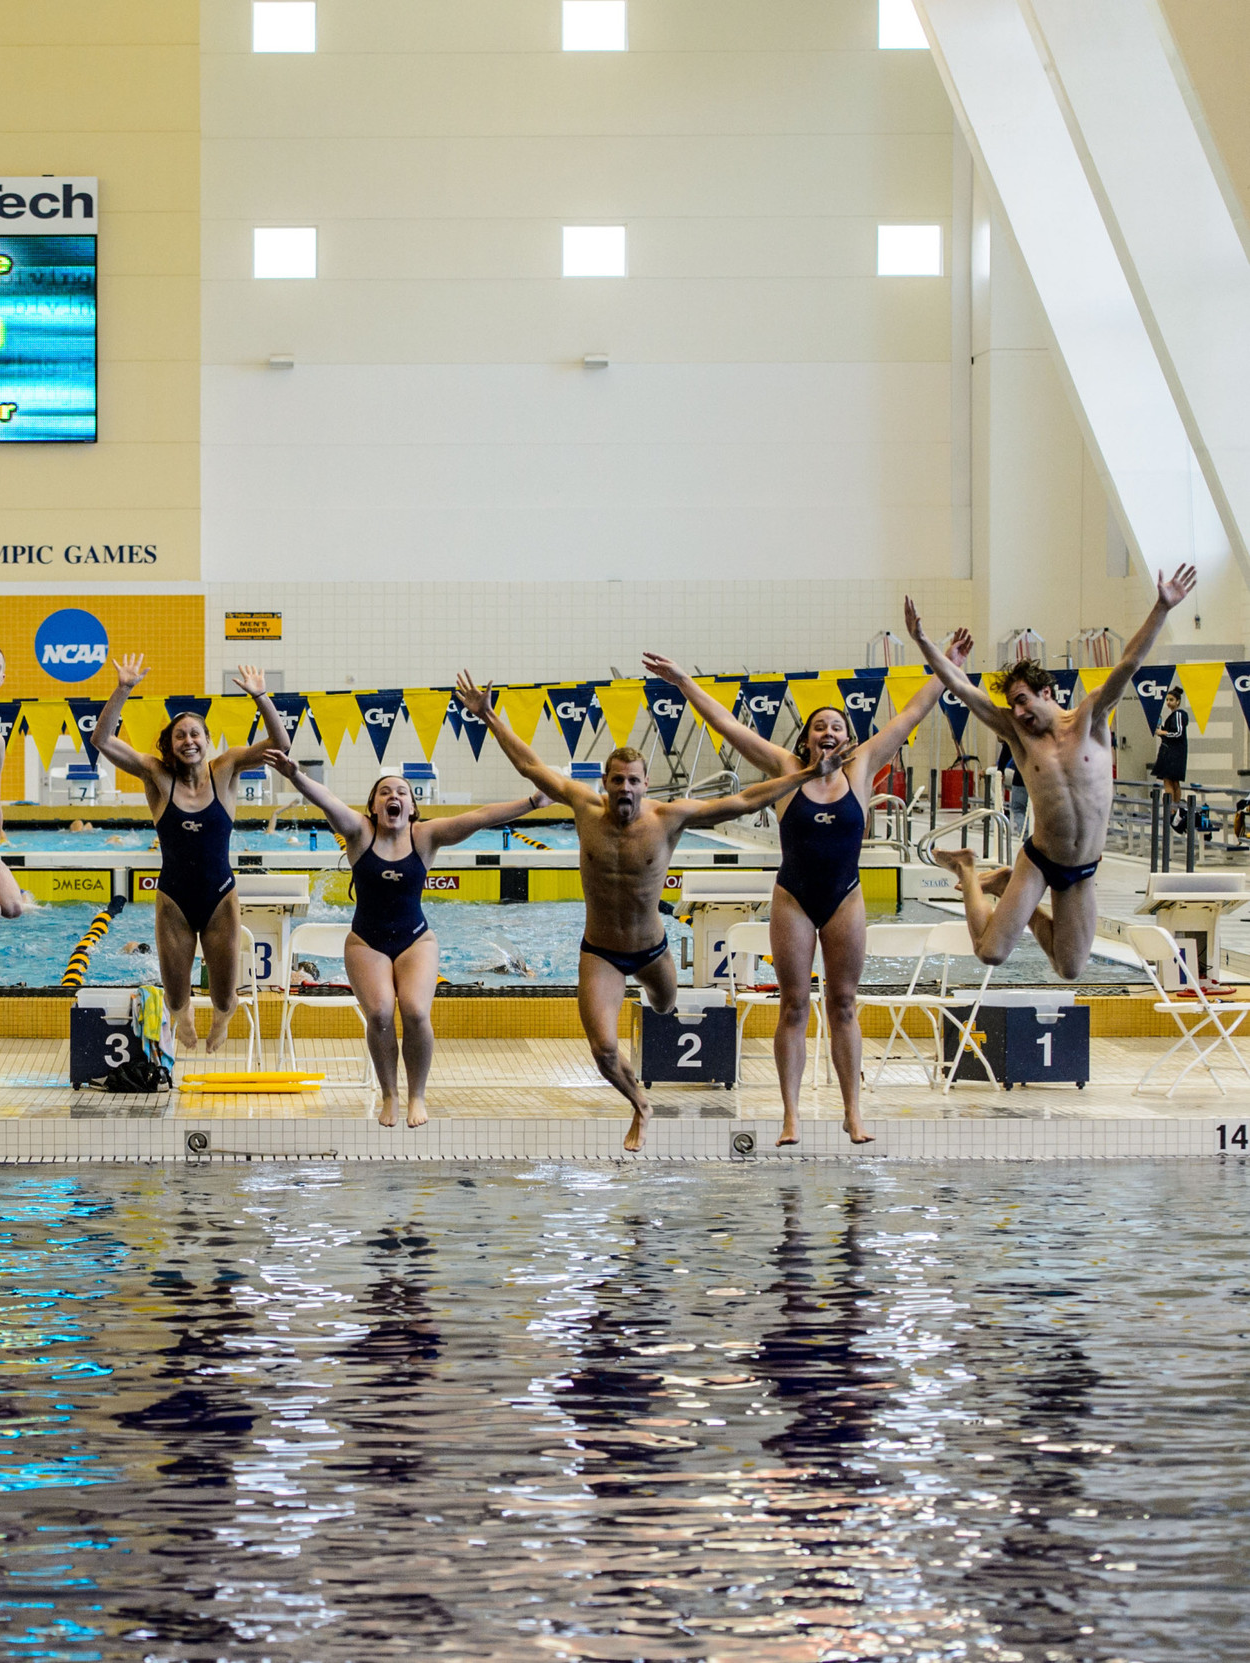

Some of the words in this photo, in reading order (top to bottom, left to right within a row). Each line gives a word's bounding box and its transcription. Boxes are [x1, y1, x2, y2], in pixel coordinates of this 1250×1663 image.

[64, 544, 157, 564] GAMES
[42, 644, 108, 664] NCAA
[1137, 680, 1168, 700] GT
[556, 701, 587, 721] GT
[653, 699, 684, 719] GT
[750, 695, 780, 715] GT
[845, 692, 876, 712] GT
[364, 708, 395, 727] GT
[79, 787, 87, 801] 7
[246, 787, 254, 801] 8
[415, 787, 423, 800] 9
[713, 940, 737, 978] 2
[104, 1033, 131, 1068] 3
[677, 1033, 702, 1068] 2
[1036, 1032, 1052, 1067] 1
[1216, 1124, 1248, 1150] 14
